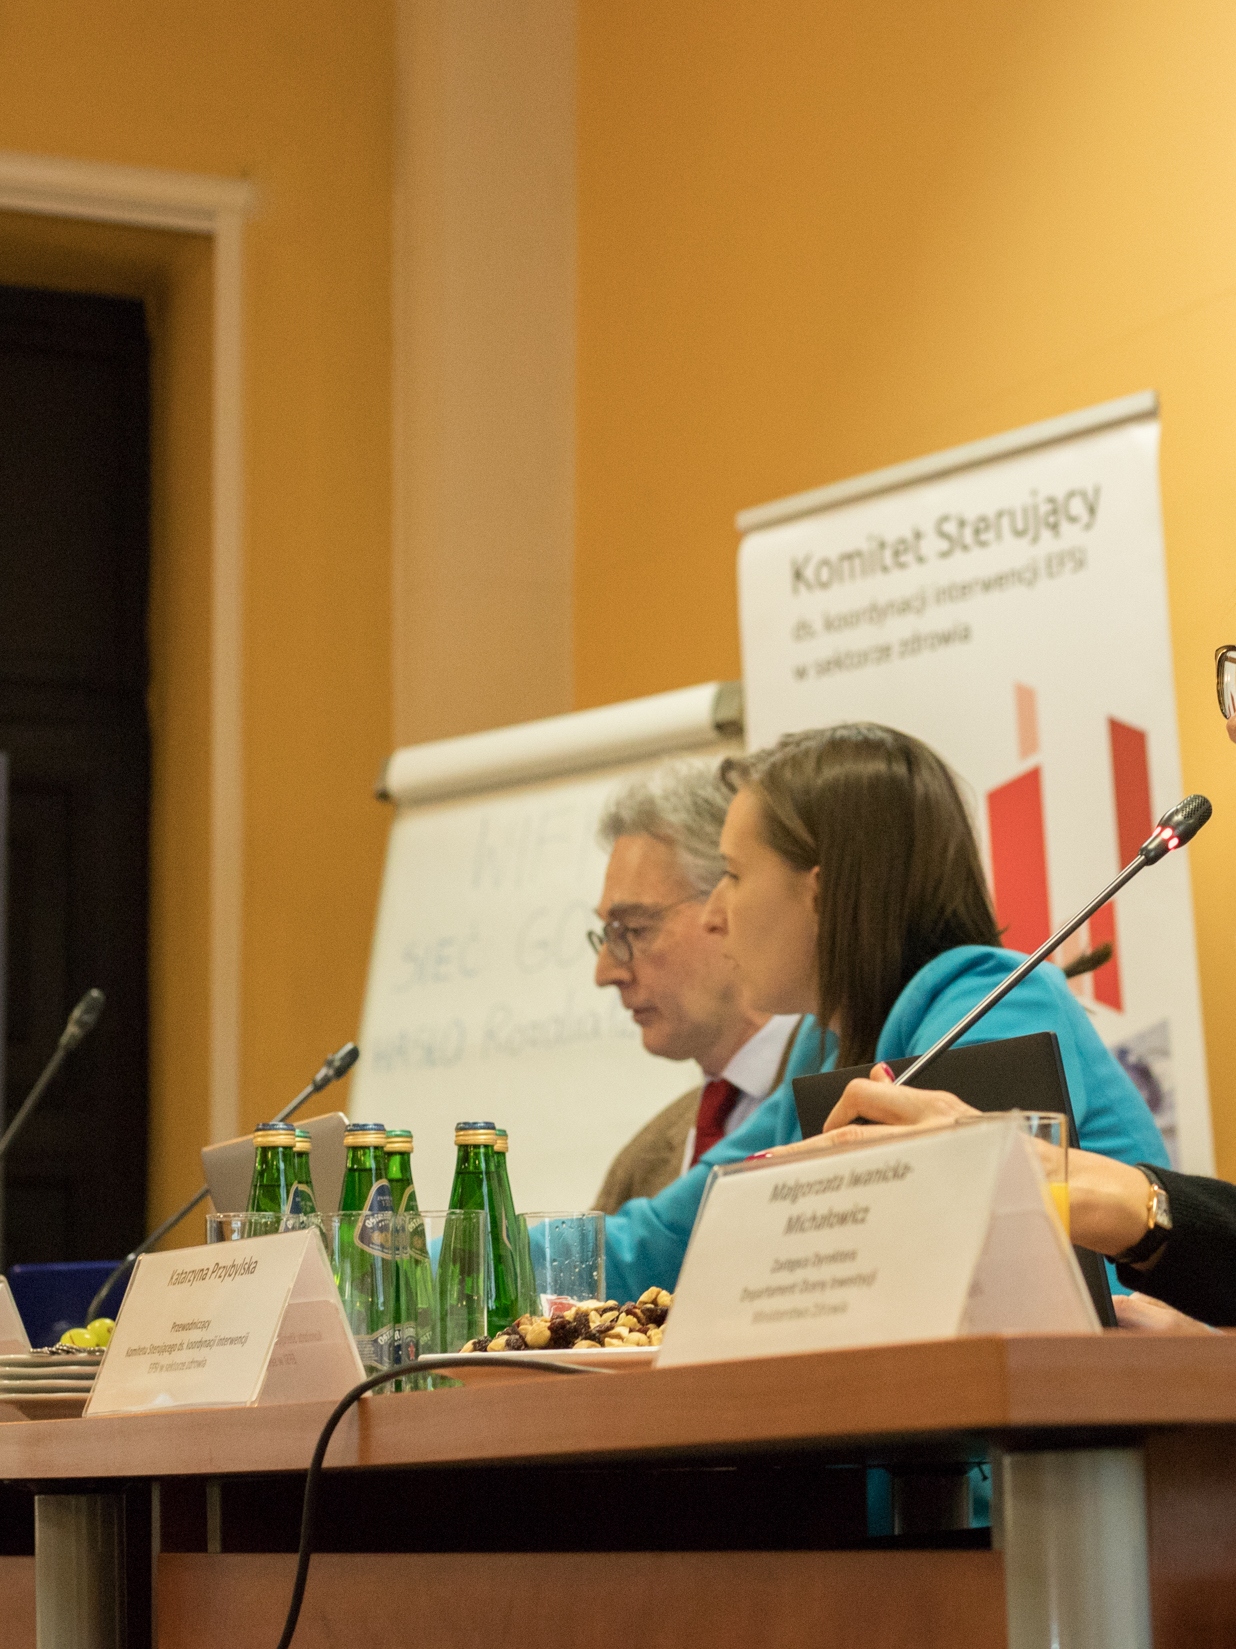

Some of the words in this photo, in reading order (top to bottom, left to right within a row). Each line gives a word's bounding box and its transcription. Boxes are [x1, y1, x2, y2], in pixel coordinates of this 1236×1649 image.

[790, 525, 928, 596] Komitet
[934, 484, 1101, 557] Sterujący
[898, 618, 973, 660] zdrowia
[167, 1267, 210, 1287] Katarzyna
[208, 1256, 258, 1283] Przybylska
[216, 1331, 250, 1348] interwencji
